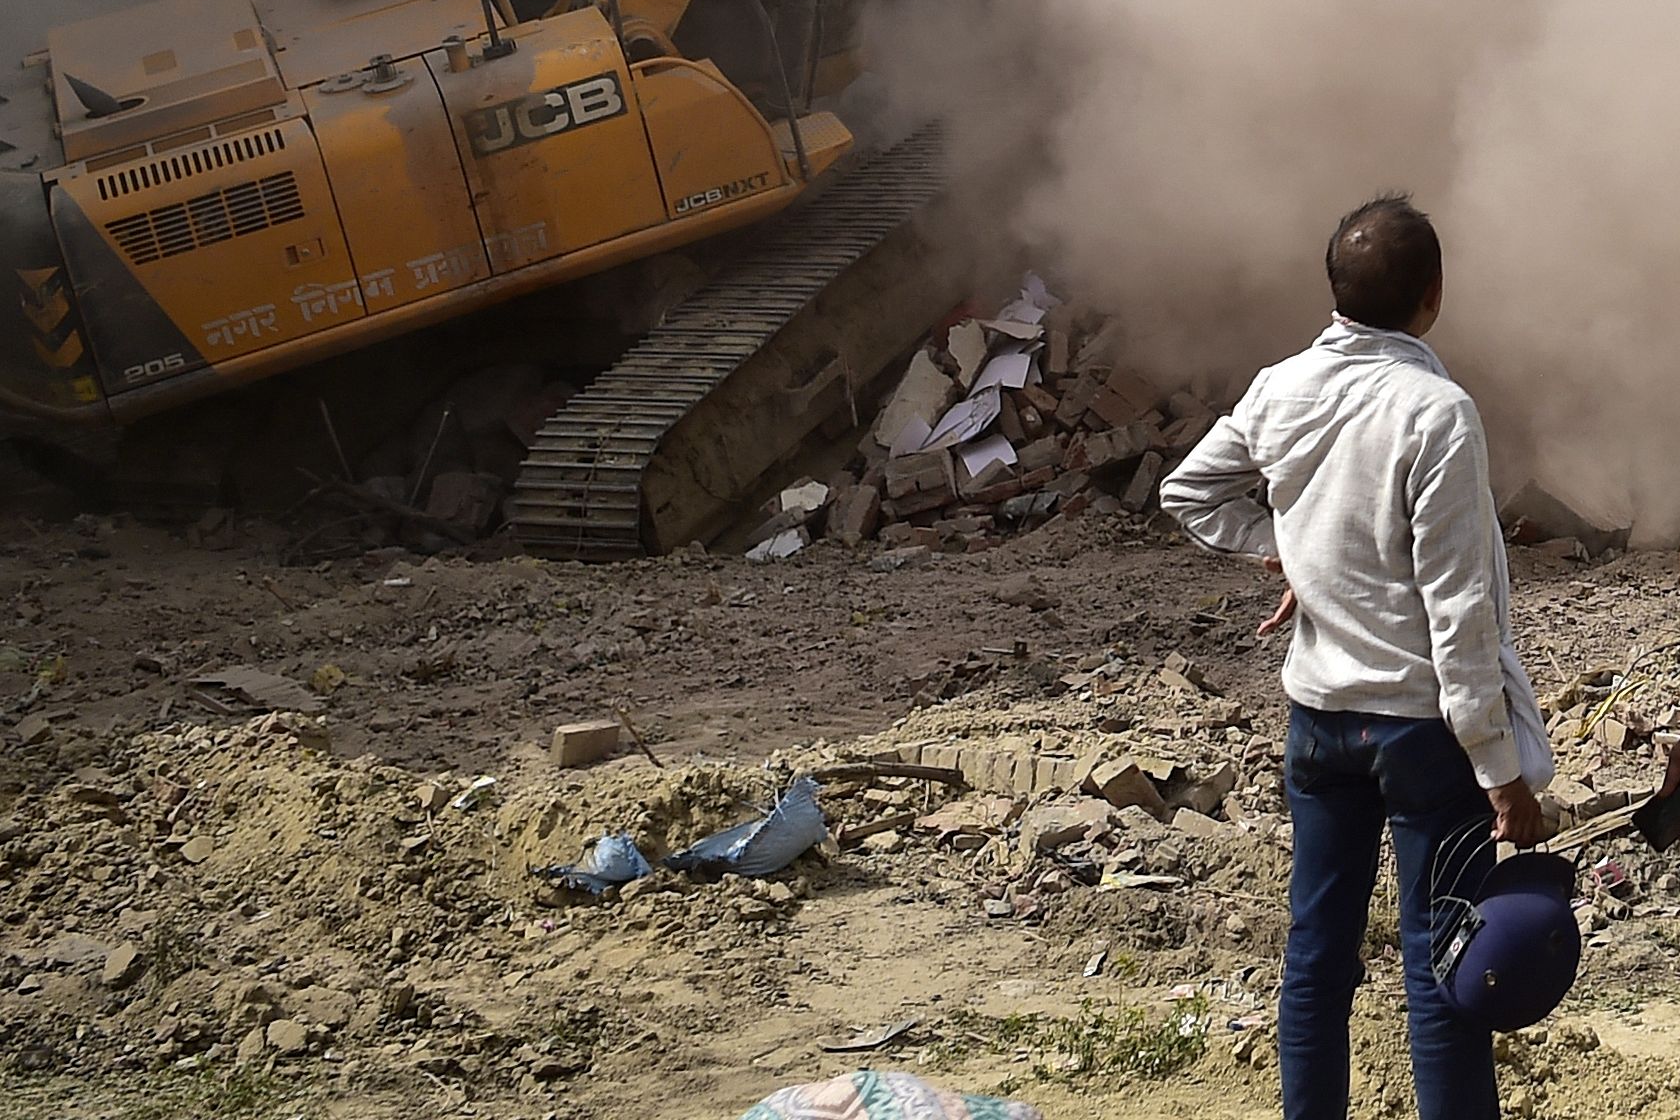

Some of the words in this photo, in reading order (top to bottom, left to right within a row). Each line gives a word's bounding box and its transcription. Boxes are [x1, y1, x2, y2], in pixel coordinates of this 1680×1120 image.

[474, 77, 622, 152] JCB
[202, 303, 279, 346] नगर
[290, 267, 396, 322] निगम
[124, 352, 185, 384] 205
